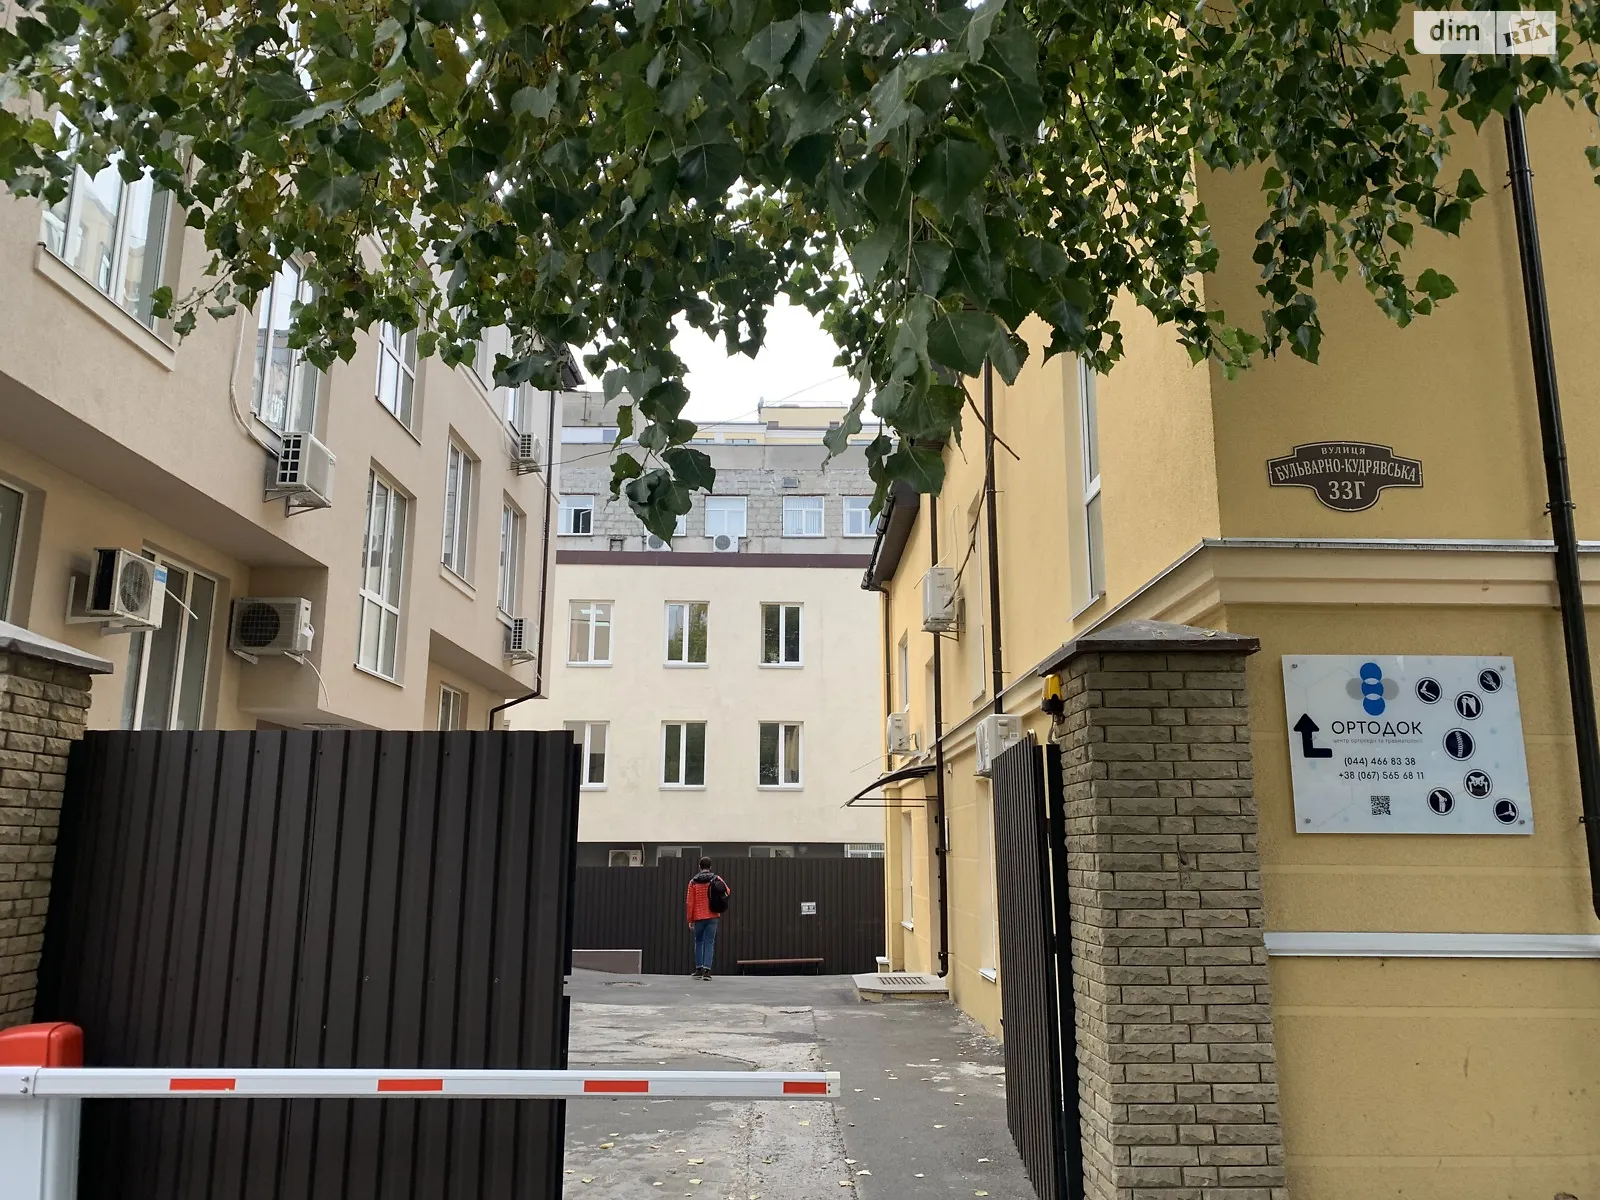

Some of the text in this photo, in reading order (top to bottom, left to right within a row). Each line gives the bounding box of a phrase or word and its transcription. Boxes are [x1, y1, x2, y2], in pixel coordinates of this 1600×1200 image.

[1321, 446, 1366, 455] ВУЛИЦЯ
[1274, 458, 1416, 481] БУЛЬВАРНО-КУДРЯВСЬКА
[1328, 480, 1365, 500] 33Г
[1331, 721, 1423, 737] ОРТОДОК
[1344, 757, 1416, 767] (044) 466 83 38
[1339, 771, 1424, 781] +38 (067) 565 68 11
